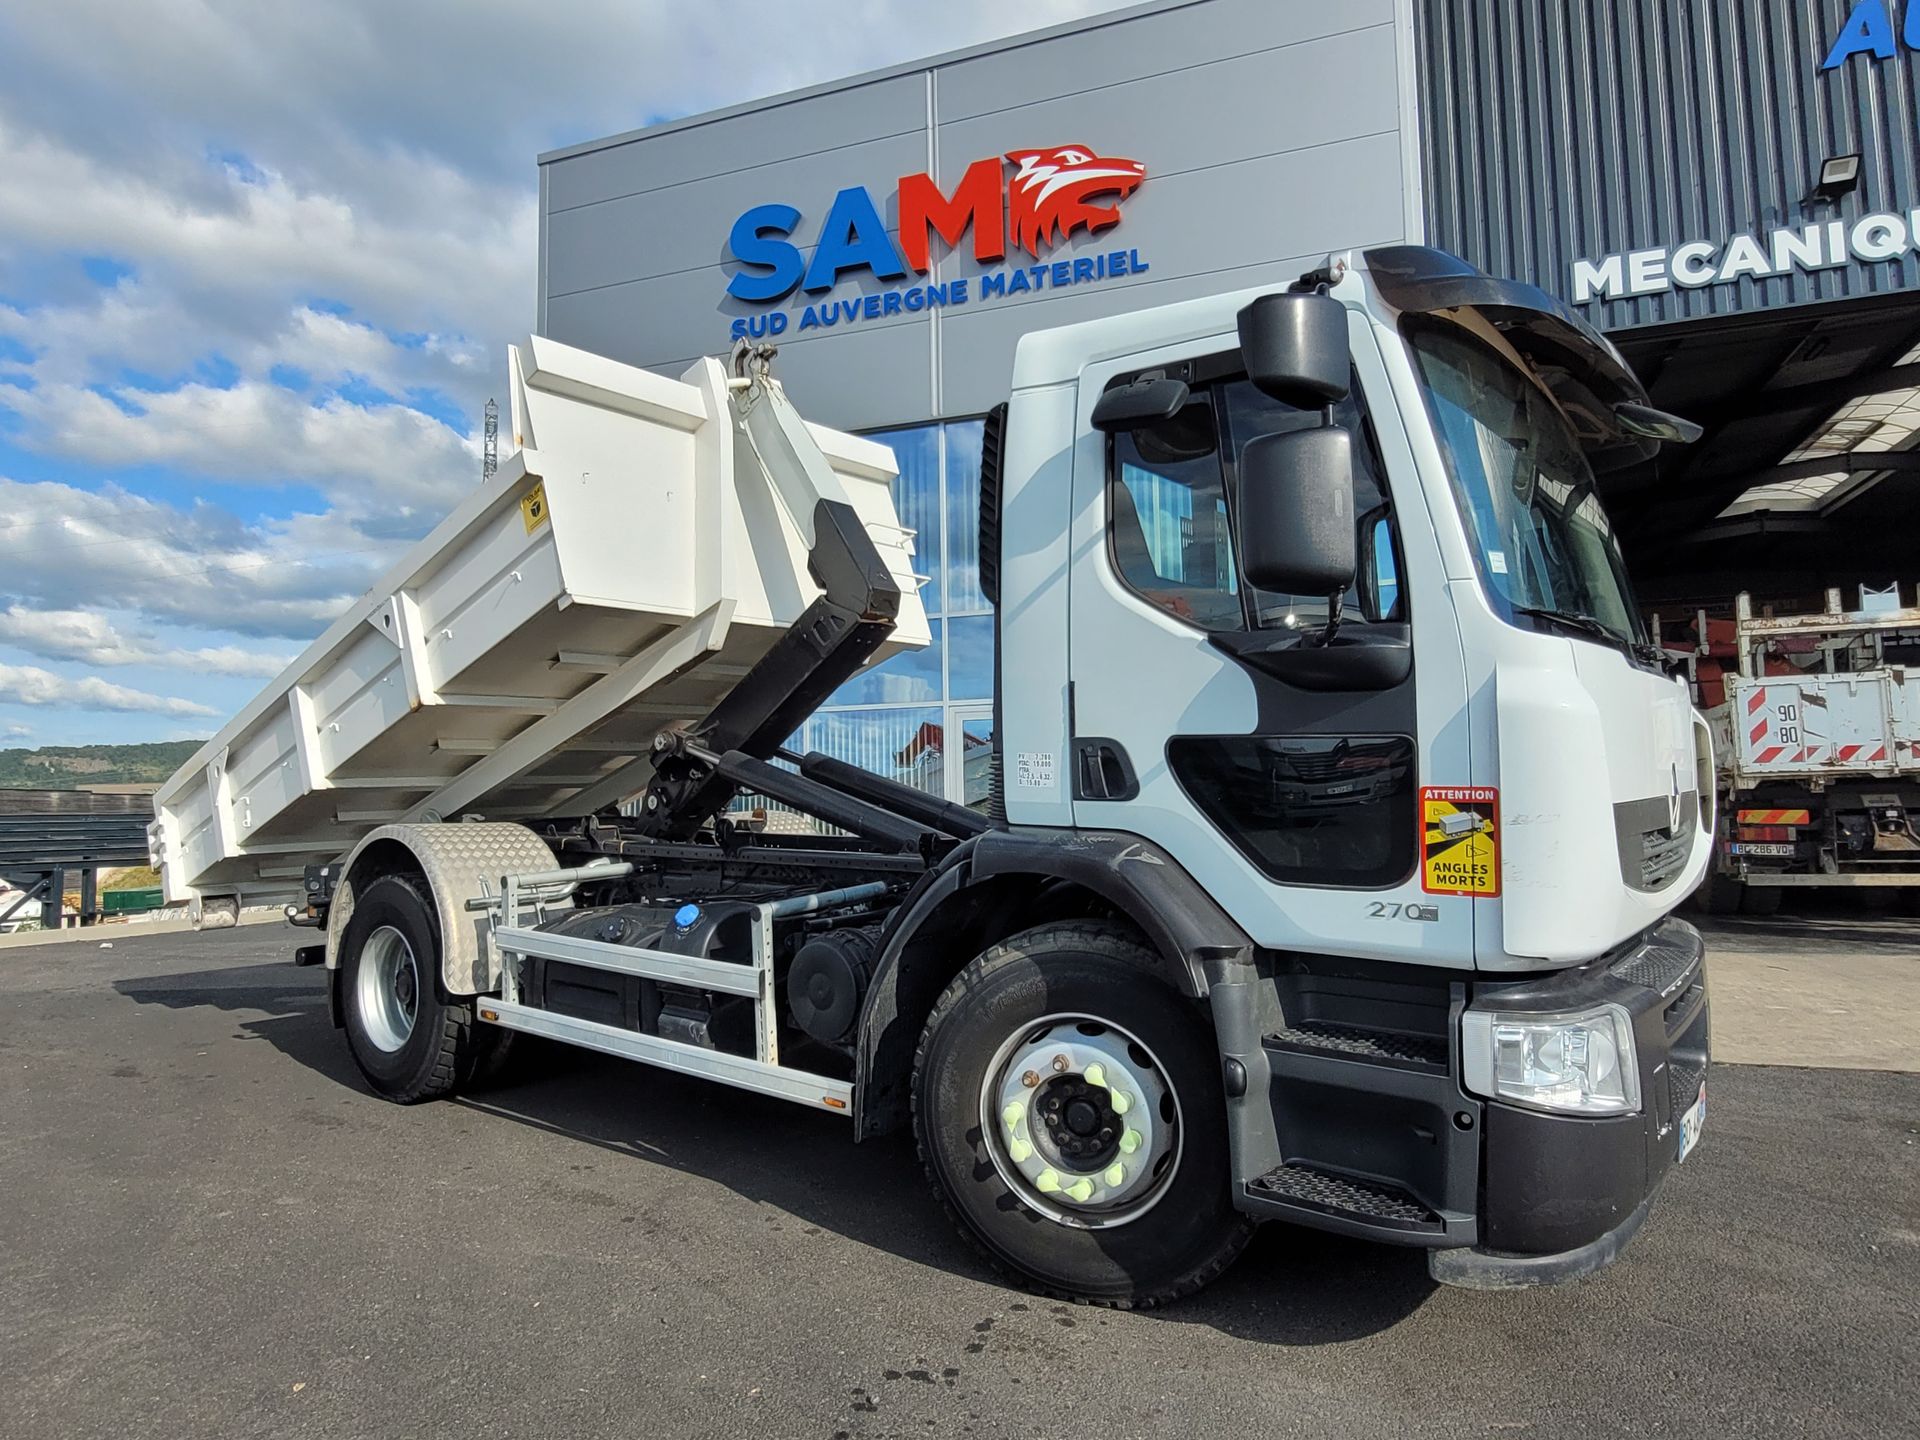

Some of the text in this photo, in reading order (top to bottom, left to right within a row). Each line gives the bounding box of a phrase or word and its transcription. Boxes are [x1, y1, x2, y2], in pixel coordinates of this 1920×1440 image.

[1821, 0, 1920, 70] A
[727, 157, 1006, 300] SAM
[1573, 210, 1920, 301] MECANIQ
[731, 248, 1150, 340] SUD AUVERGNE MATERIEL
[1778, 705, 1797, 722] 90
[1780, 727, 1799, 743] 80
[1425, 790, 1494, 800] ATTENTION
[1433, 862, 1488, 875] ANGLES
[1436, 874, 1486, 887] MORTS
[1369, 901, 1421, 920] 270
